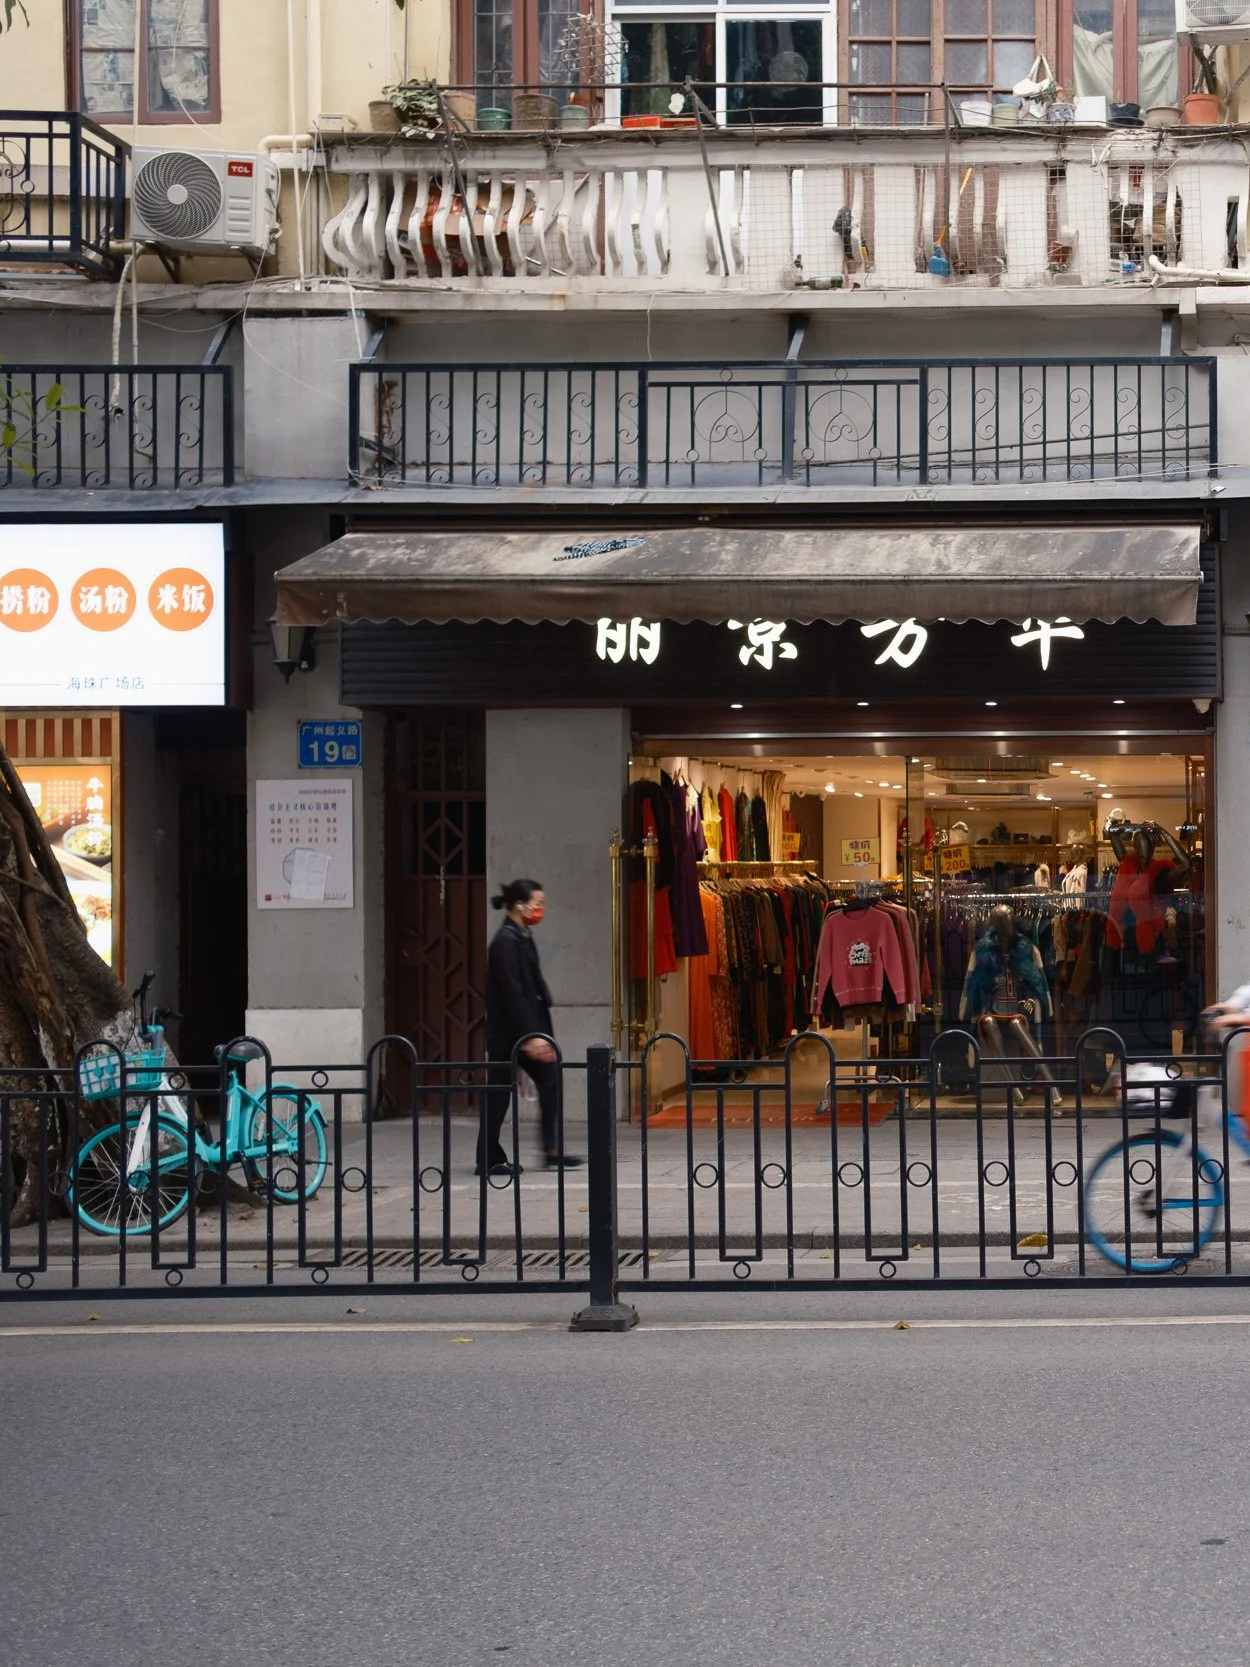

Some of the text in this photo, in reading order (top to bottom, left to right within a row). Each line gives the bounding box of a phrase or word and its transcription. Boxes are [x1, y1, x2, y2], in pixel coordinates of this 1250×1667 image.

[230, 165, 250, 173] TCL
[0, 583, 206, 615] 捞粉 汤粉 米饭
[68, 676, 145, 691] 海珠广场店
[302, 725, 358, 736] 广州起义路
[309, 741, 339, 763] 19
